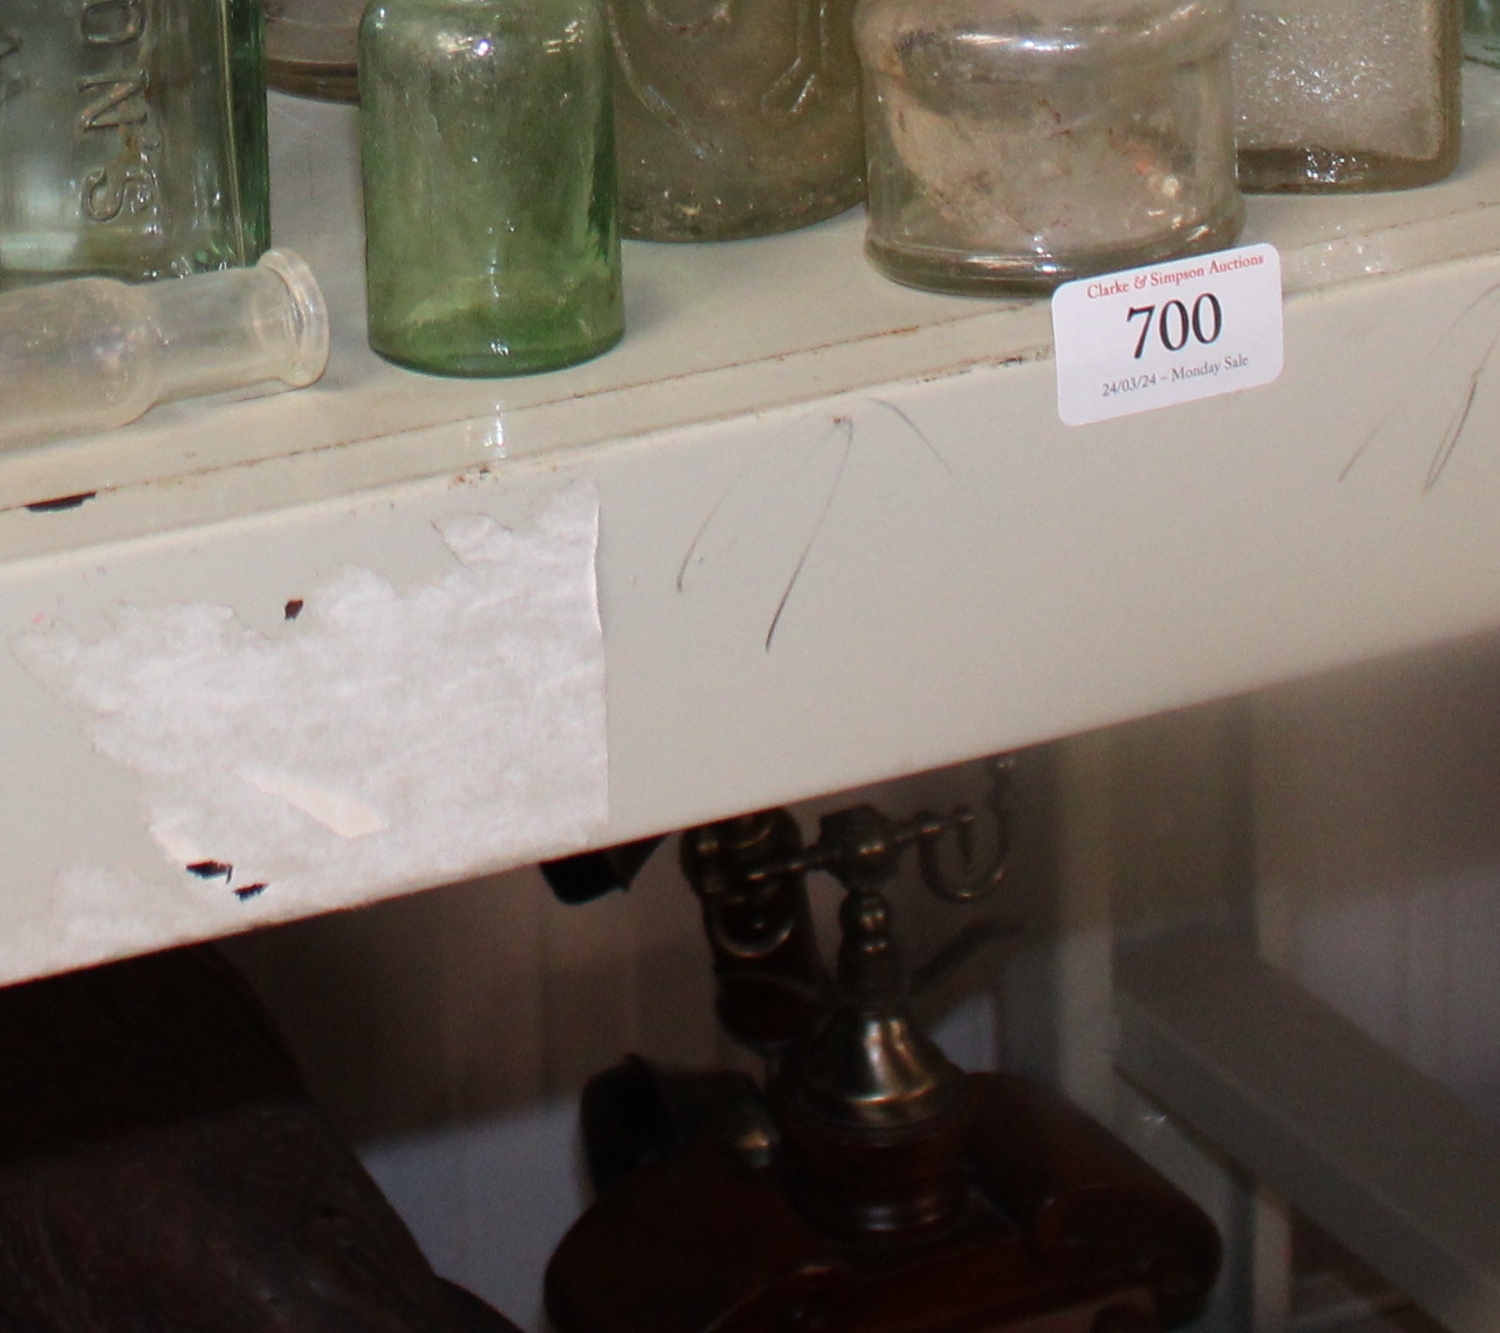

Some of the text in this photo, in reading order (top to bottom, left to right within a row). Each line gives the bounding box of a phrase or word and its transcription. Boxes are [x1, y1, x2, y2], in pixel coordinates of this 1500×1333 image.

[1086, 254, 1265, 300] Clarke & Simpson Auctions
[1126, 292, 1223, 360] 700
[1102, 372, 1158, 398] 24/03/24
[1170, 359, 1222, 383] Monday
[1223, 353, 1250, 372] Sale
